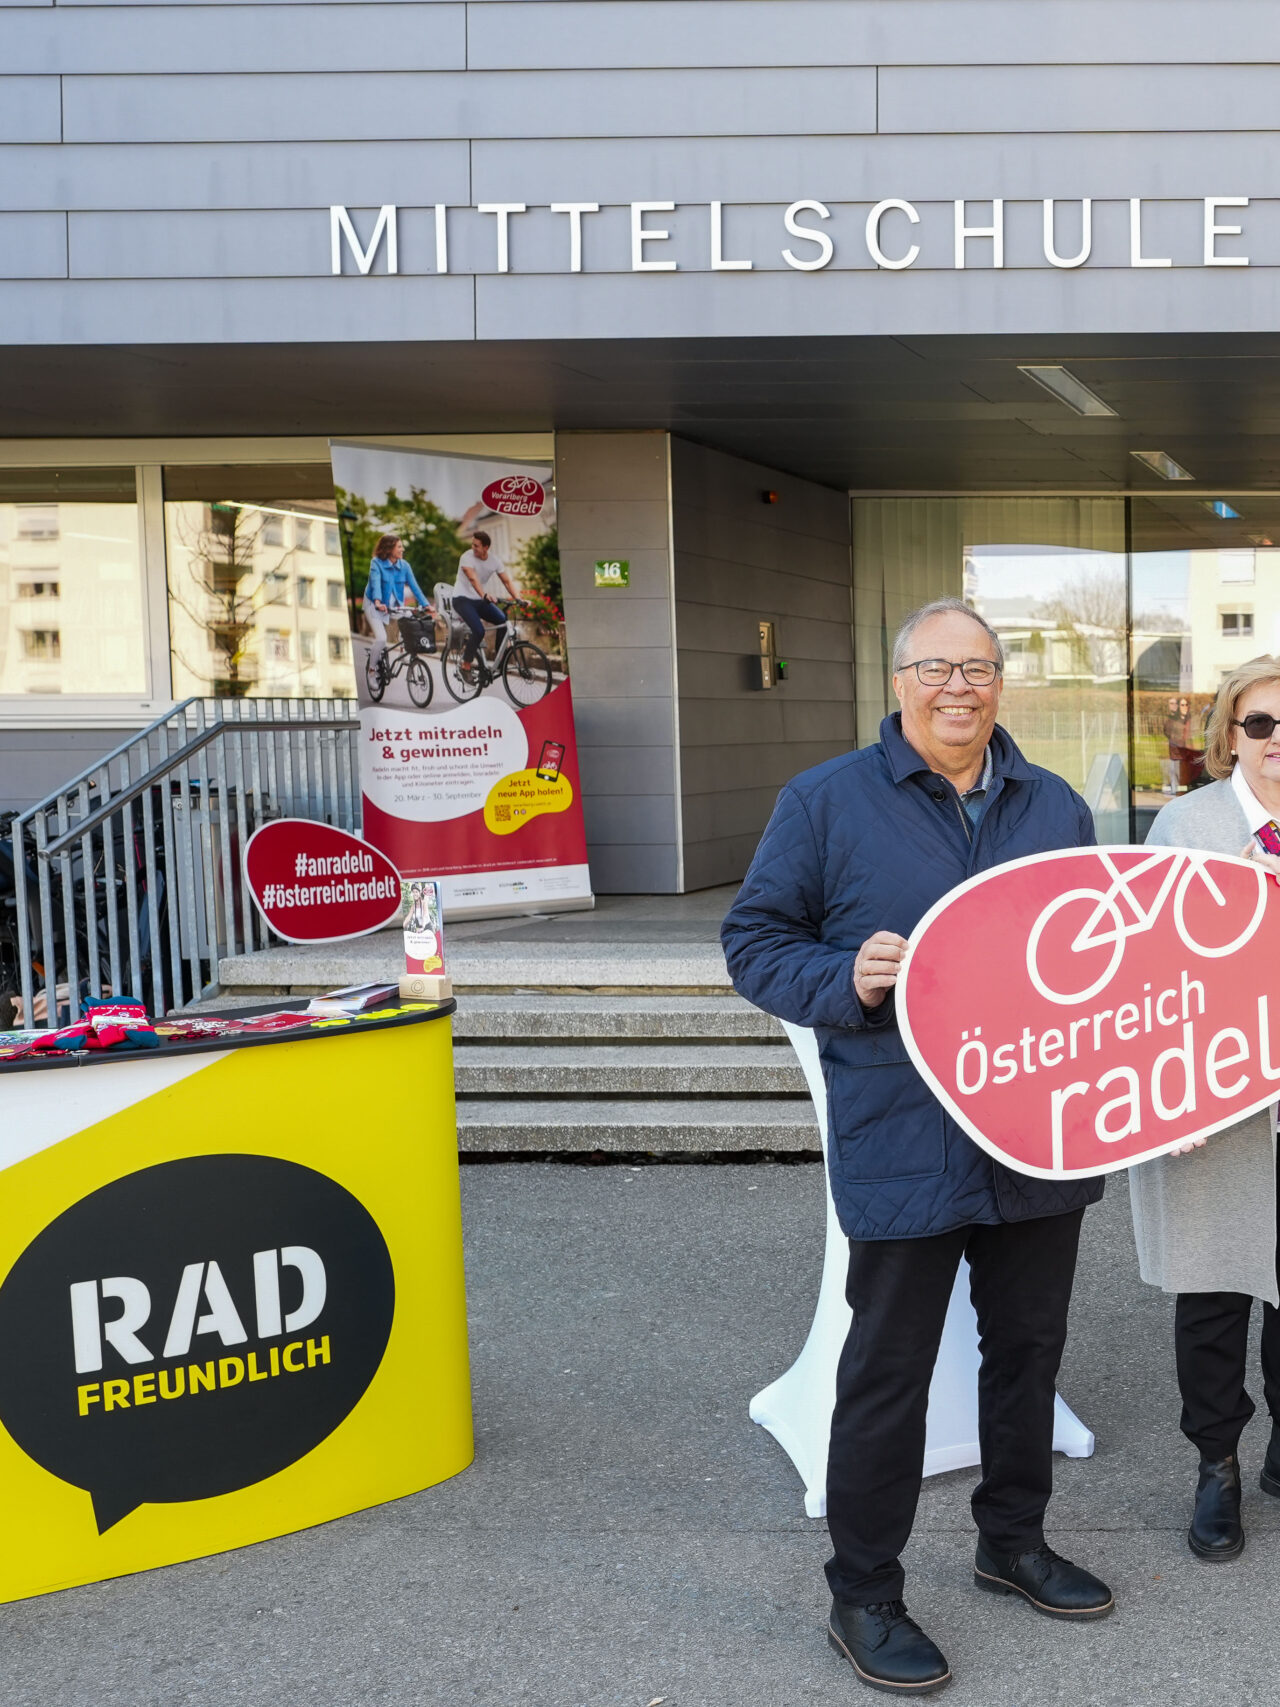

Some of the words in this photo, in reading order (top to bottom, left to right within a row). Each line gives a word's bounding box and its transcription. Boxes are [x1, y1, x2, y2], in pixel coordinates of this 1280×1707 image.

[330, 197, 1249, 276] MITTELSCHULE
[491, 491, 528, 502] Vorarlberg
[496, 500, 541, 514] radelt
[603, 562, 621, 578] 16
[369, 728, 413, 742] Jetzt
[419, 725, 503, 740] mitradeln
[382, 746, 395, 759] &
[400, 743, 489, 762] gewinnen!
[407, 793, 425, 801] März
[445, 791, 482, 801] September
[520, 790, 535, 798] App
[538, 788, 563, 796] holen!
[295, 850, 373, 878] #anradeln
[263, 875, 396, 909] #österreichradelt
[955, 970, 1206, 1095] Österreich
[70, 1246, 327, 1374] RAD
[77, 1335, 331, 1416] FREUNDLICH
